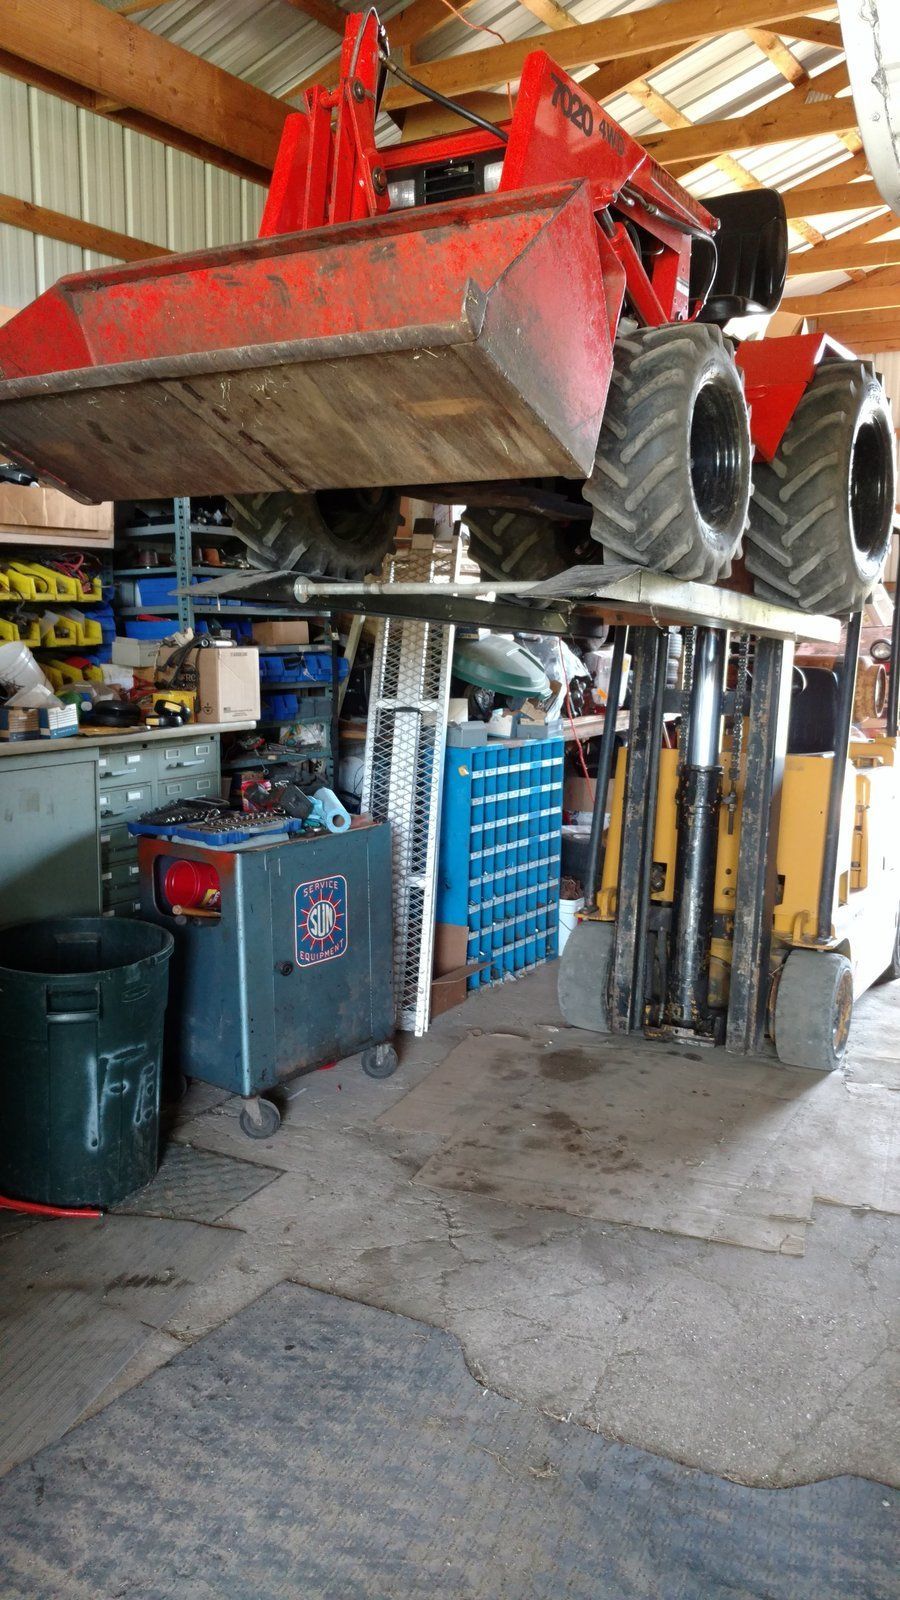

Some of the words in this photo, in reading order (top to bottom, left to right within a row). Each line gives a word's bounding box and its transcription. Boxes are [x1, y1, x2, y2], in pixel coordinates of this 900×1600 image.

[550, 71, 594, 137] 7020
[599, 118, 625, 156] 4WD
[303, 880, 339, 898] SERVICE
[310, 903, 333, 937] SUN
[300, 938, 344, 962] EQUIPMENT
